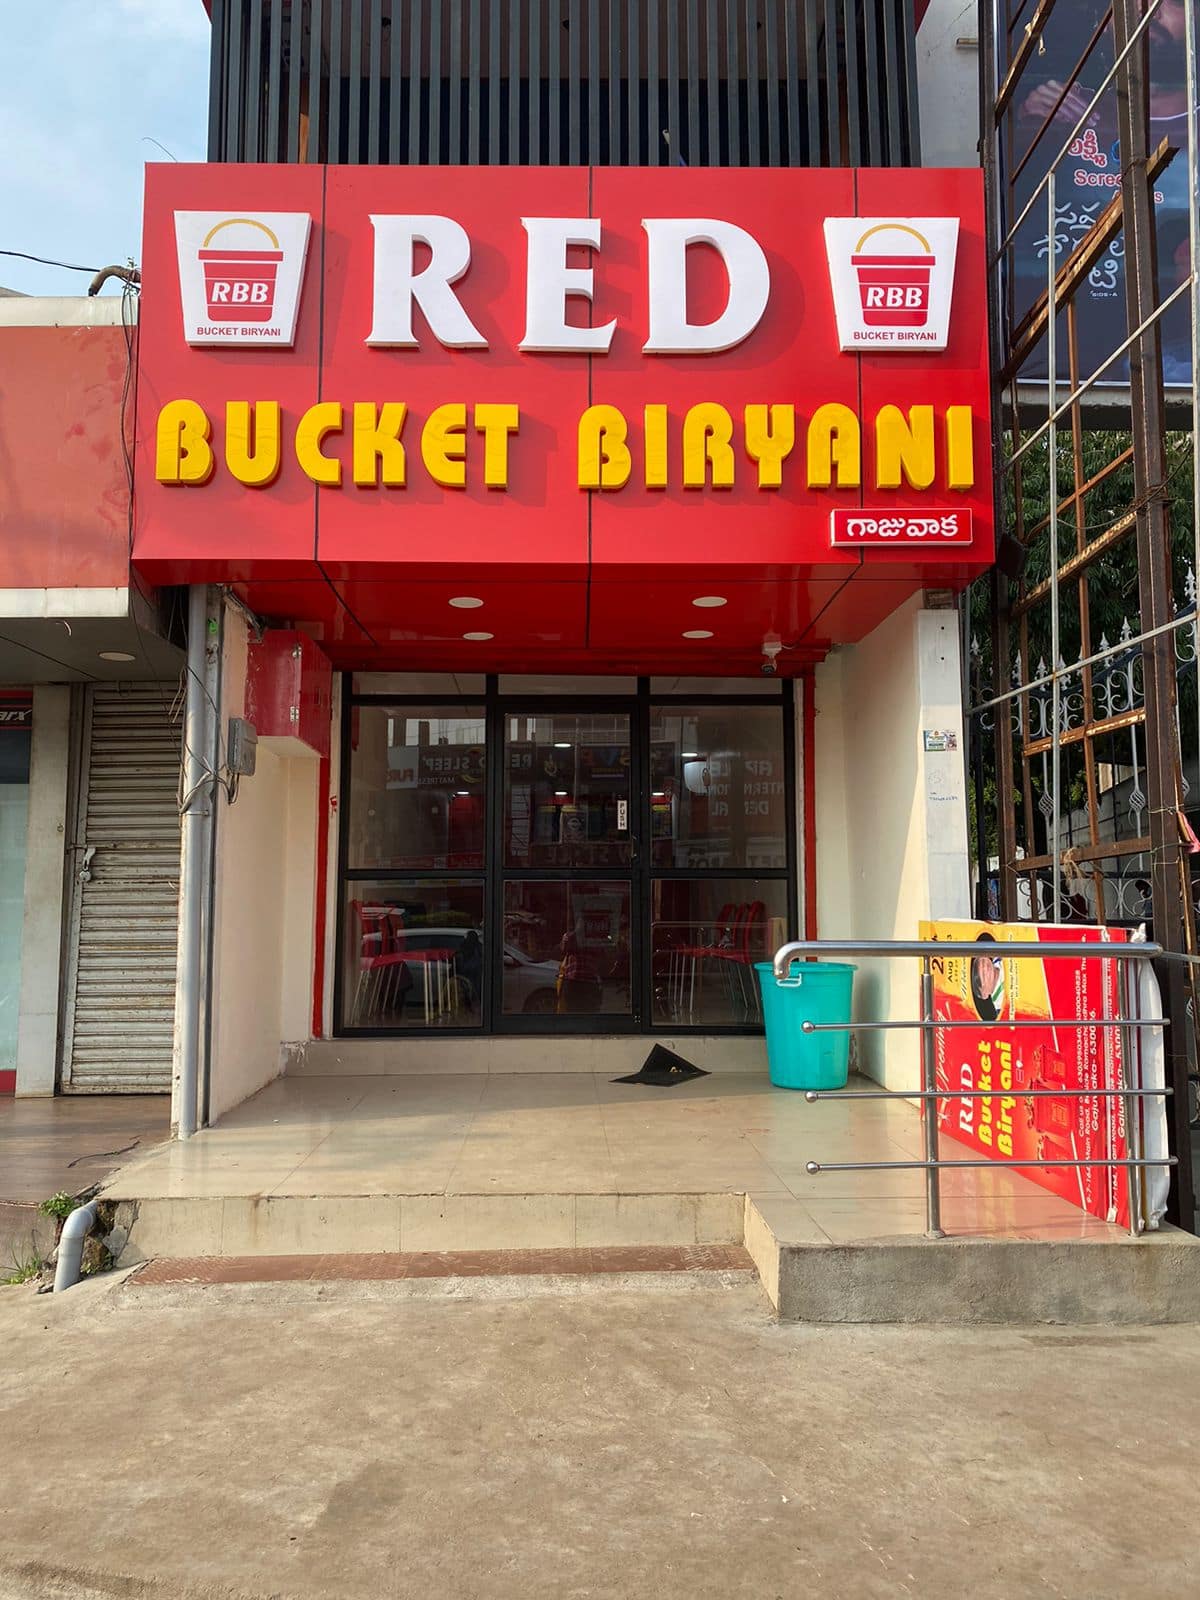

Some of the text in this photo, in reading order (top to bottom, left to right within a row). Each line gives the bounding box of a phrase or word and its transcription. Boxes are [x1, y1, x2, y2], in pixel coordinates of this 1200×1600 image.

[211, 282, 269, 303] RBB
[364, 214, 771, 355] RED
[866, 287, 923, 308] RBB
[197, 327, 281, 336] BUCKET BIRYANI
[853, 331, 937, 341] BUCKET BIRYANI
[155, 399, 975, 491] BUCKET BIRYANI
[847, 514, 959, 537] గాజువాక
[959, 1063, 974, 1136] RED
[977, 1040, 993, 1147] Bucket
[996, 1040, 1017, 1157] Biryani
